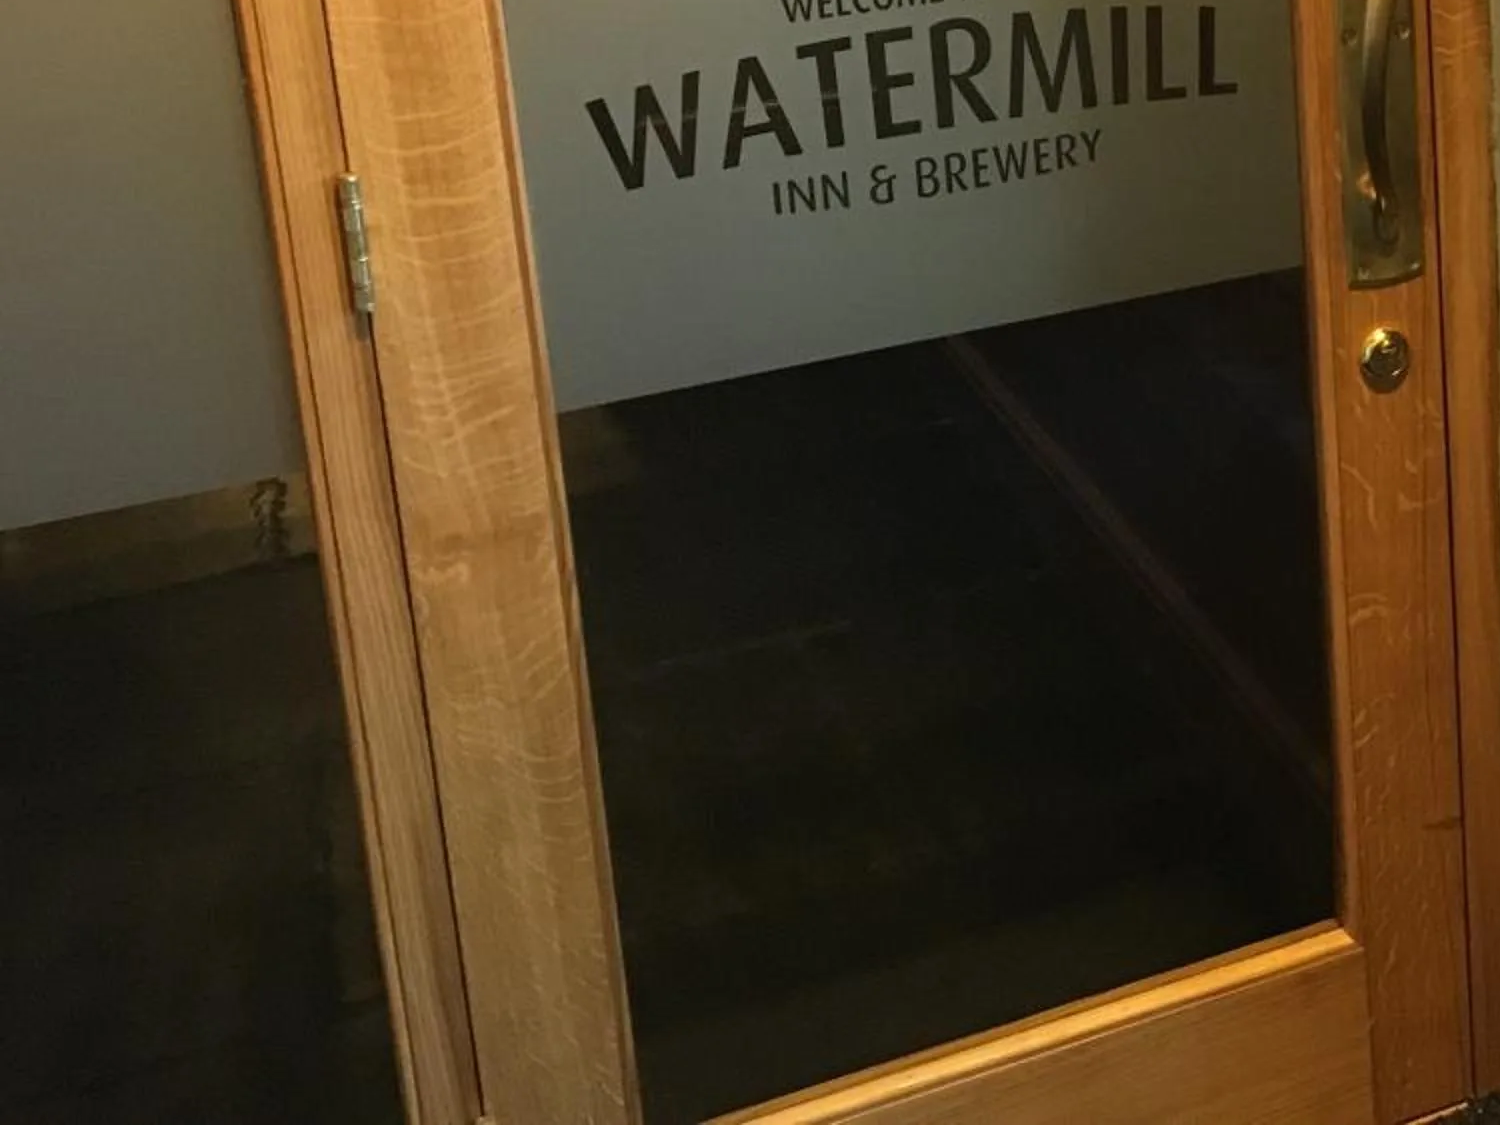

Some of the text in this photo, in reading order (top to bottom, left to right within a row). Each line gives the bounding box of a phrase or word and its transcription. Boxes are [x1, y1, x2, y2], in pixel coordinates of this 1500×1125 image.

[583, 4, 1239, 193] WATERMILL
[771, 127, 1104, 216] INN & BREWERY
